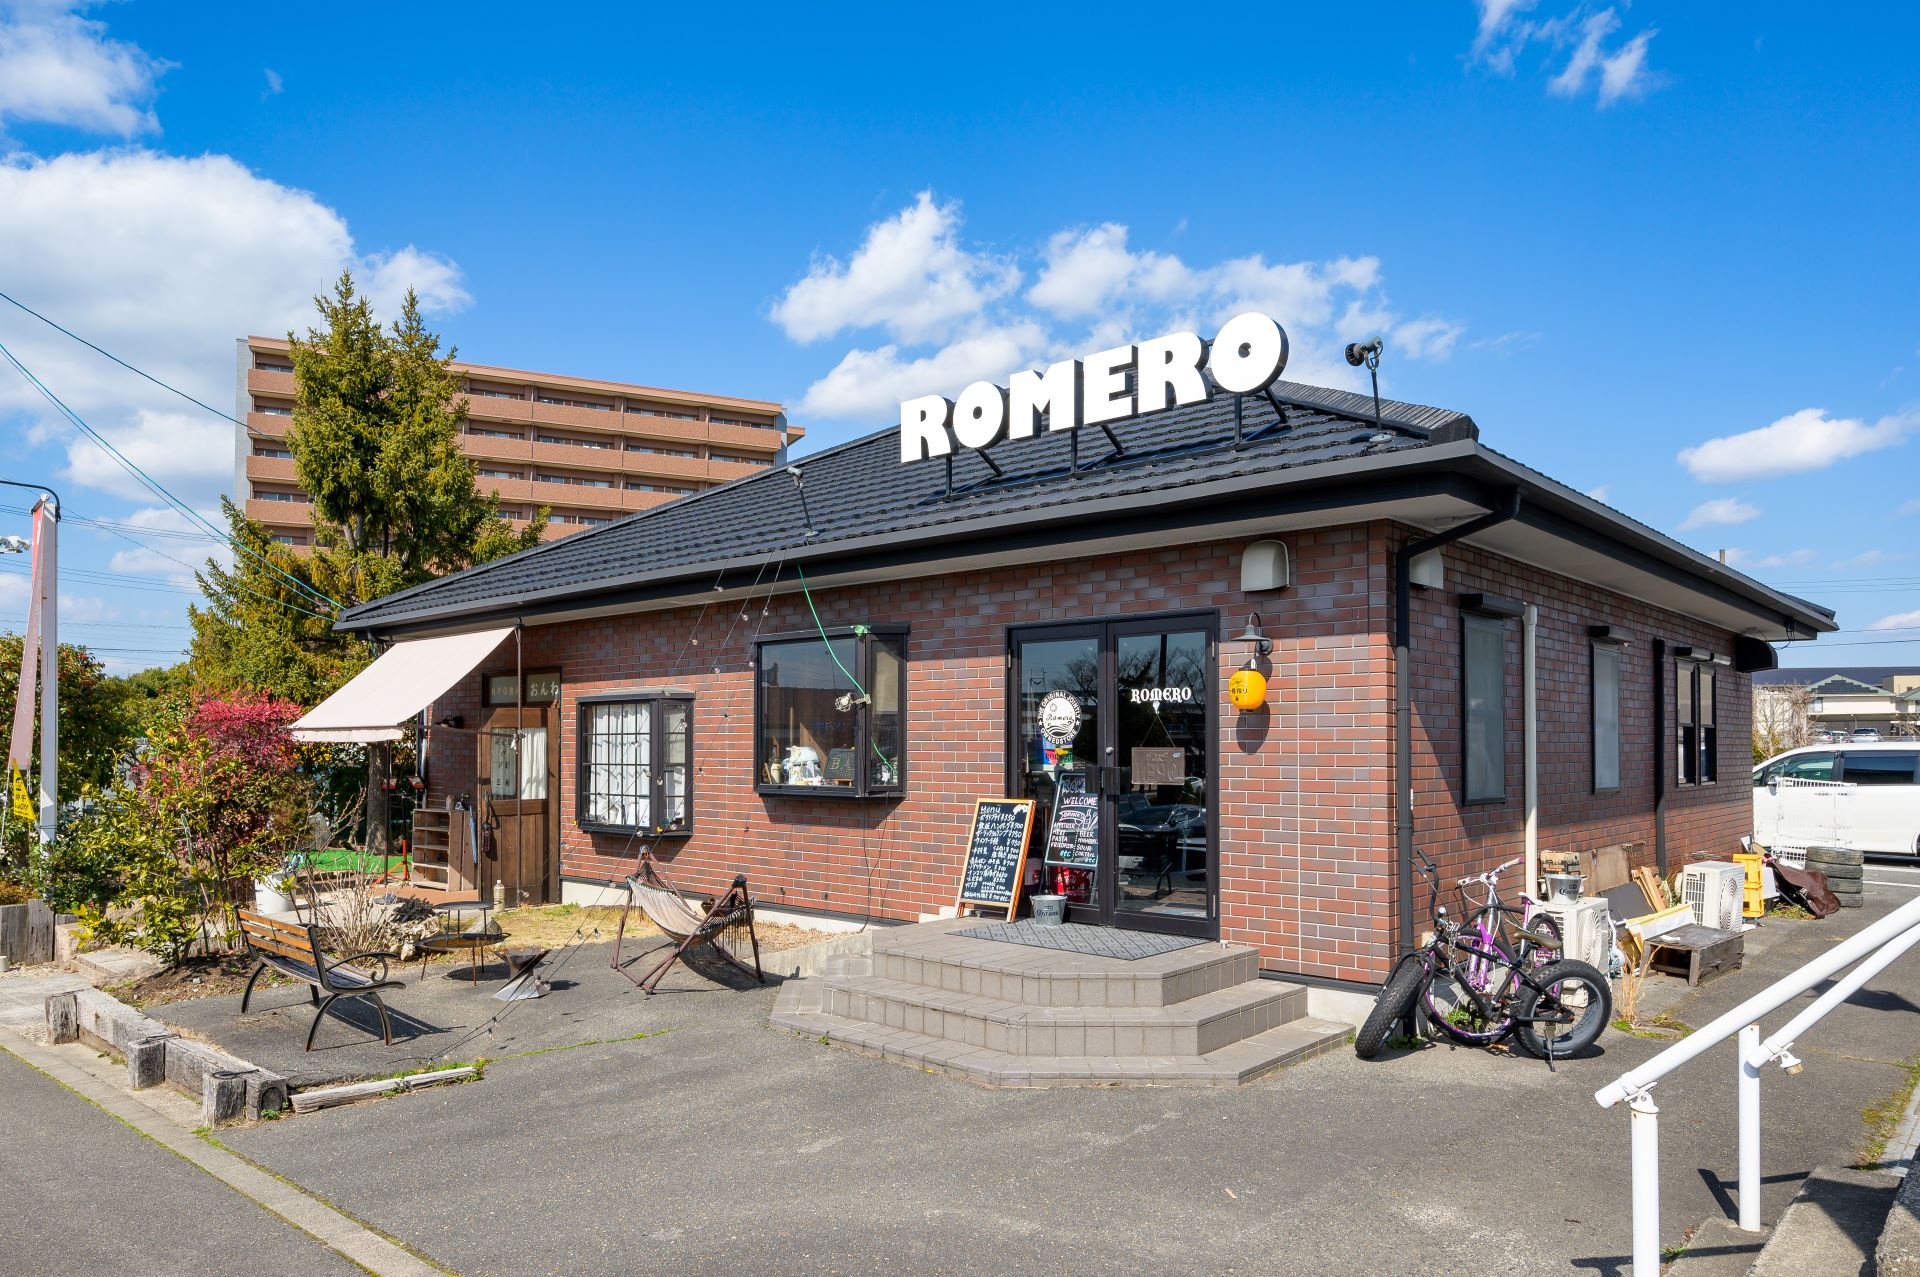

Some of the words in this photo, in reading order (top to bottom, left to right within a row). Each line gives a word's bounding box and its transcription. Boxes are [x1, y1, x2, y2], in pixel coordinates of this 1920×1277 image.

[901, 311, 1289, 464] ROMERO
[1130, 687, 1192, 704] ROMERO
[1041, 691, 1067, 707] ORIGINAL
[1066, 695, 1081, 719] JOINTLY
[1063, 797, 1098, 806] WELCOME
[980, 805, 1001, 813] Menu
[1076, 844, 1092, 852] SOUR
[1060, 849, 1072, 857] etc
